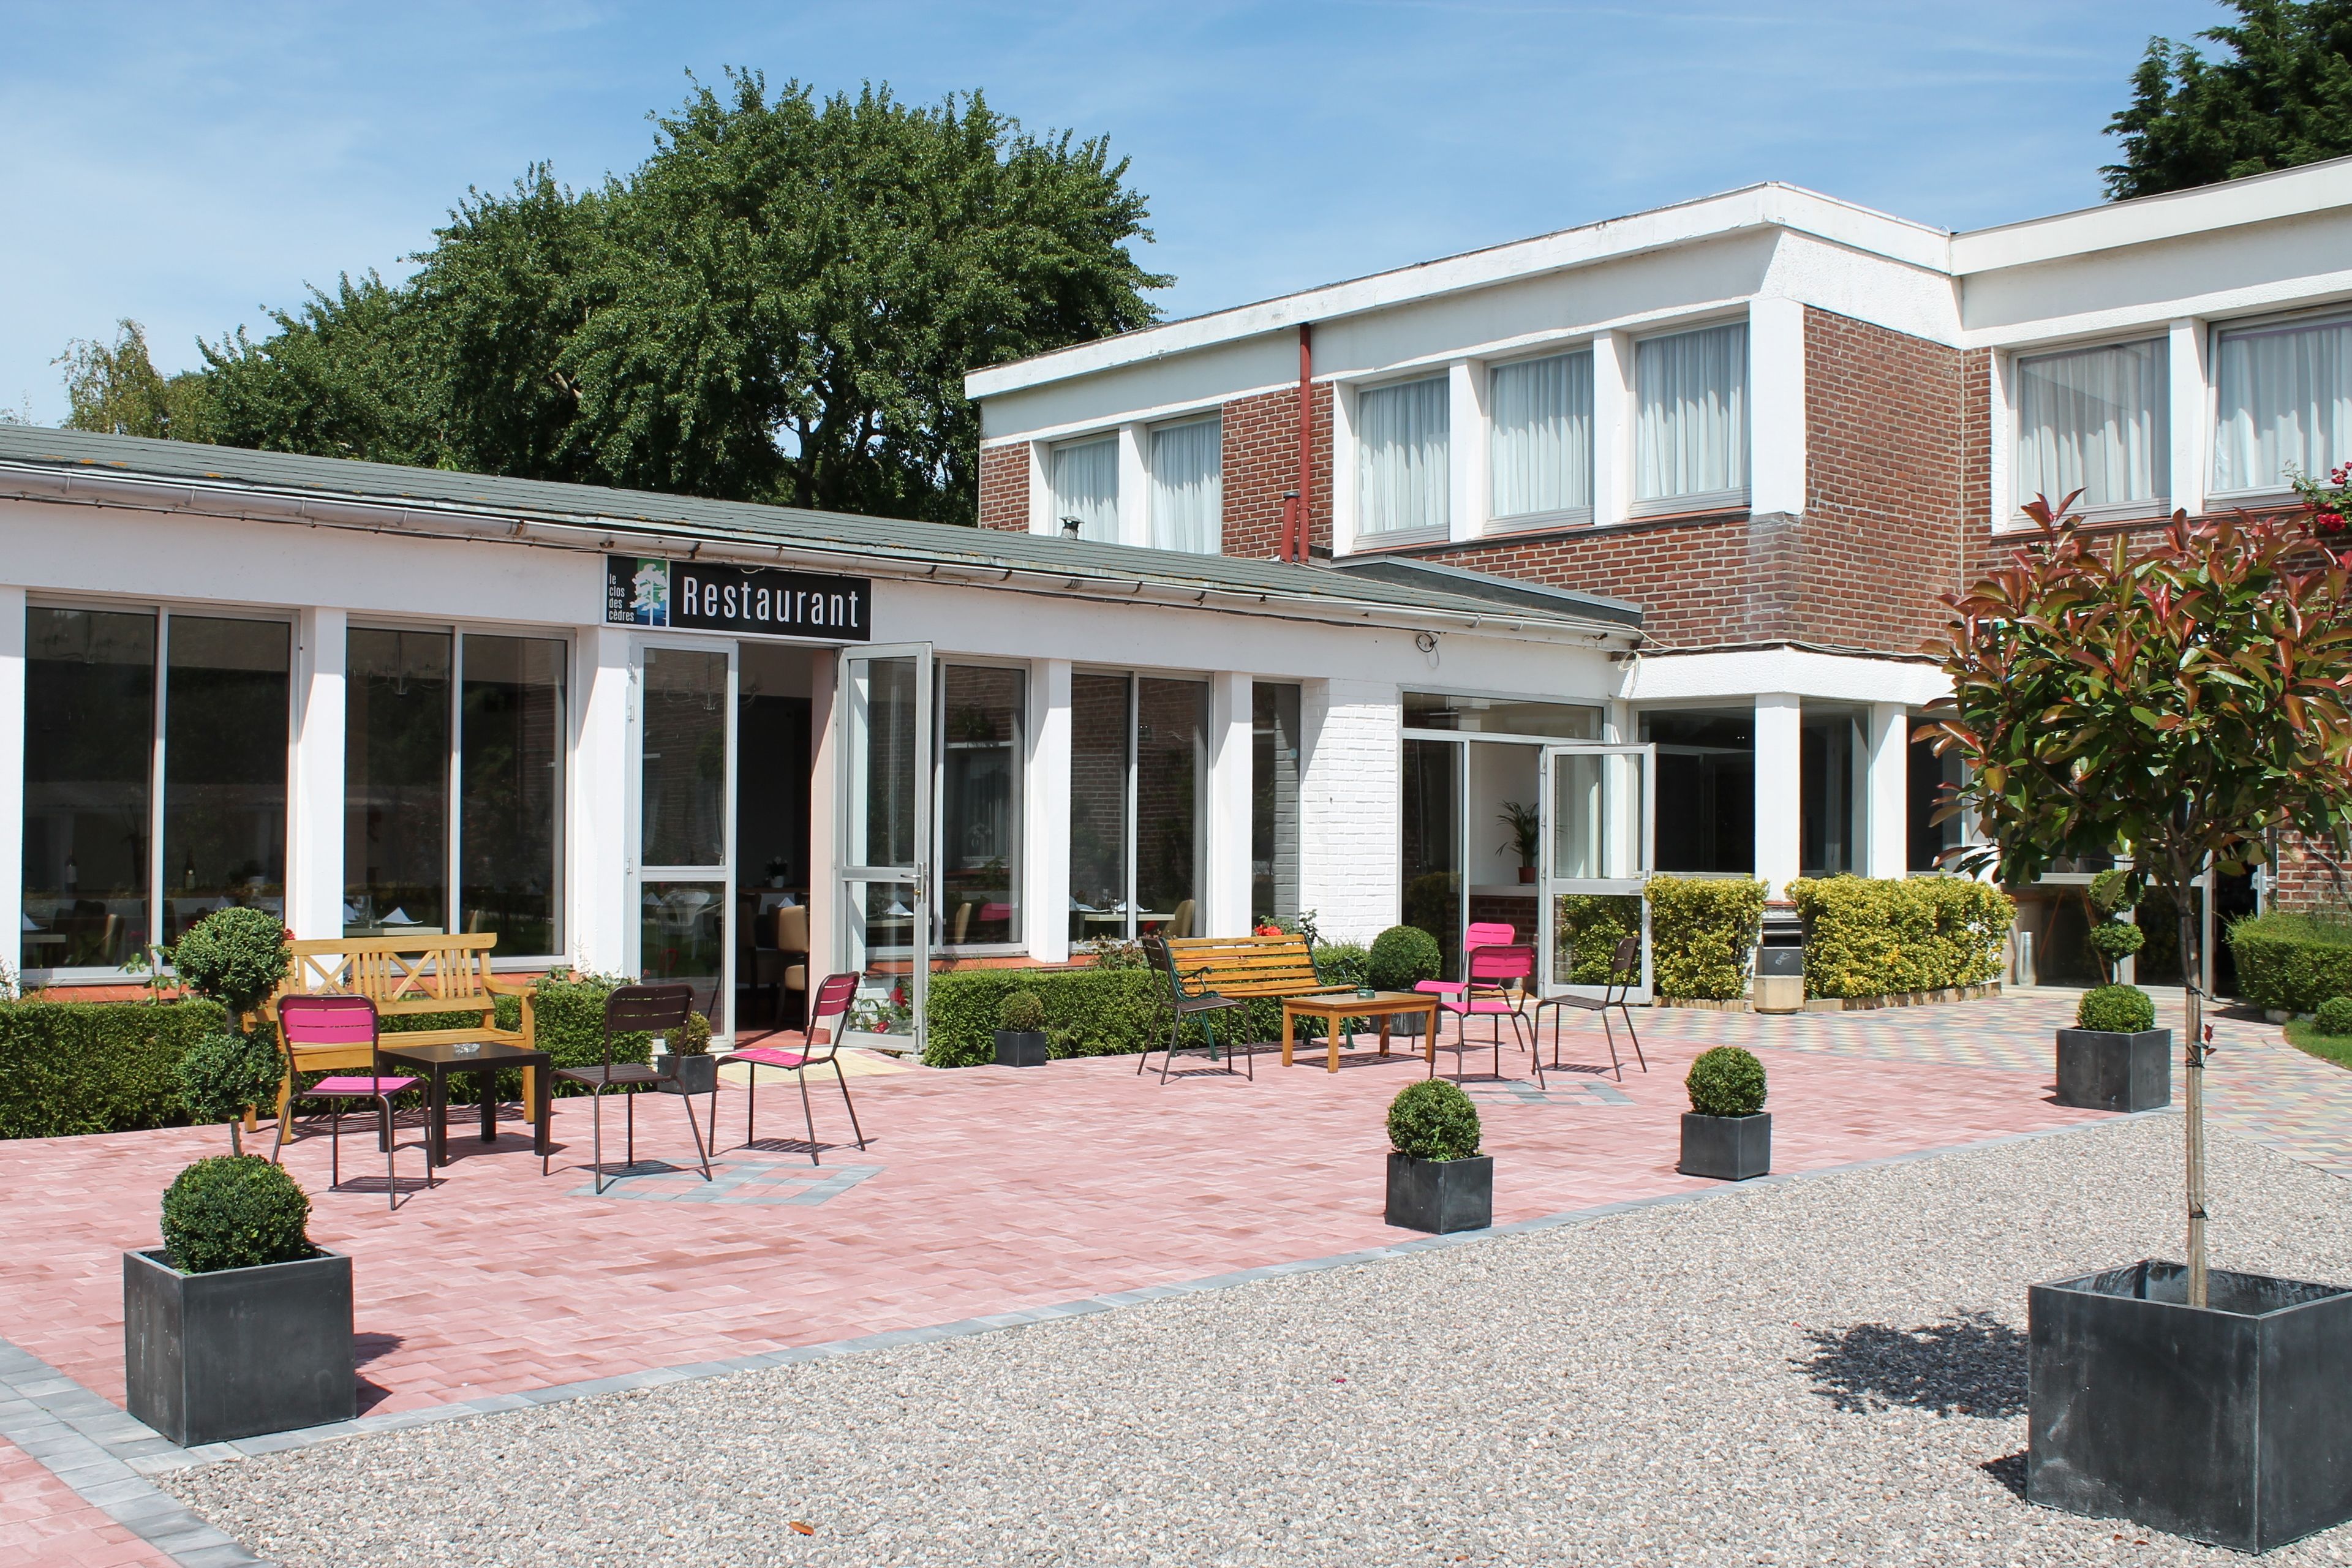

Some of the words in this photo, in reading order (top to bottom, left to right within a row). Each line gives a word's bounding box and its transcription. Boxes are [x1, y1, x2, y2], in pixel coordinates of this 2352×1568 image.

[609, 573, 616, 584] le
[609, 586, 625, 597] clos
[609, 597, 622, 609] des
[683, 576, 858, 628] Restaurant
[608, 609, 634, 621] cèdres
